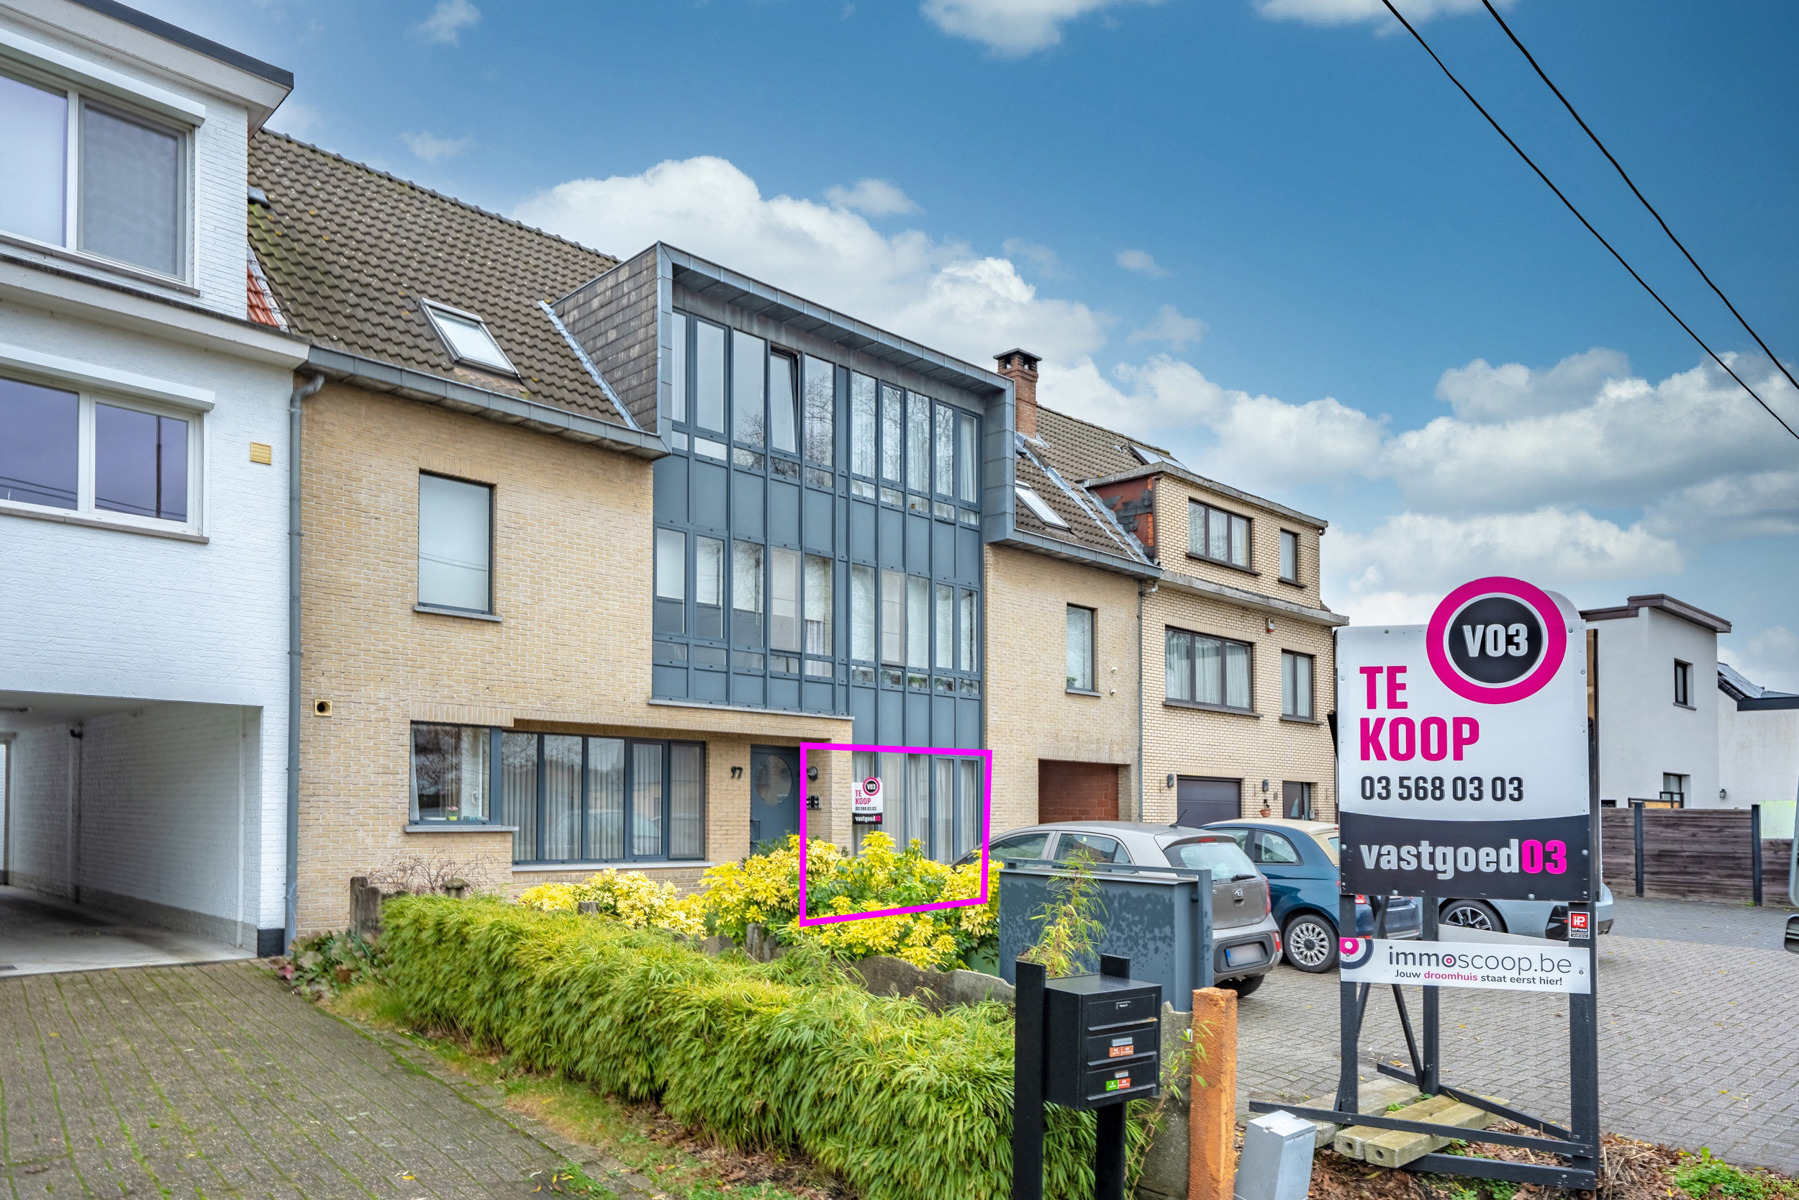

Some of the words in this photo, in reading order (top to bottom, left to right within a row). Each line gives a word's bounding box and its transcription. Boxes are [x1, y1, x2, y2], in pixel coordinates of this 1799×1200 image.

[1359, 665, 1408, 710] TE
[1359, 716, 1480, 762] KOOP
[730, 765, 743, 779] 97
[855, 789, 862, 797] TE
[855, 797, 871, 805] KOOP
[1360, 775, 1392, 801] 03
[1398, 776, 1445, 801] 568
[1452, 776, 1484, 802] 03
[1491, 776, 1524, 802] 03
[1359, 838, 1567, 880] vastgoed03
[1388, 945, 1572, 976] immoscoop.be
[1395, 969, 1421, 978] Jouw
[1424, 970, 1478, 981] droomhuis
[1481, 974, 1507, 983] staat
[1509, 976, 1537, 985] eerst
[1539, 976, 1563, 986] hier!
